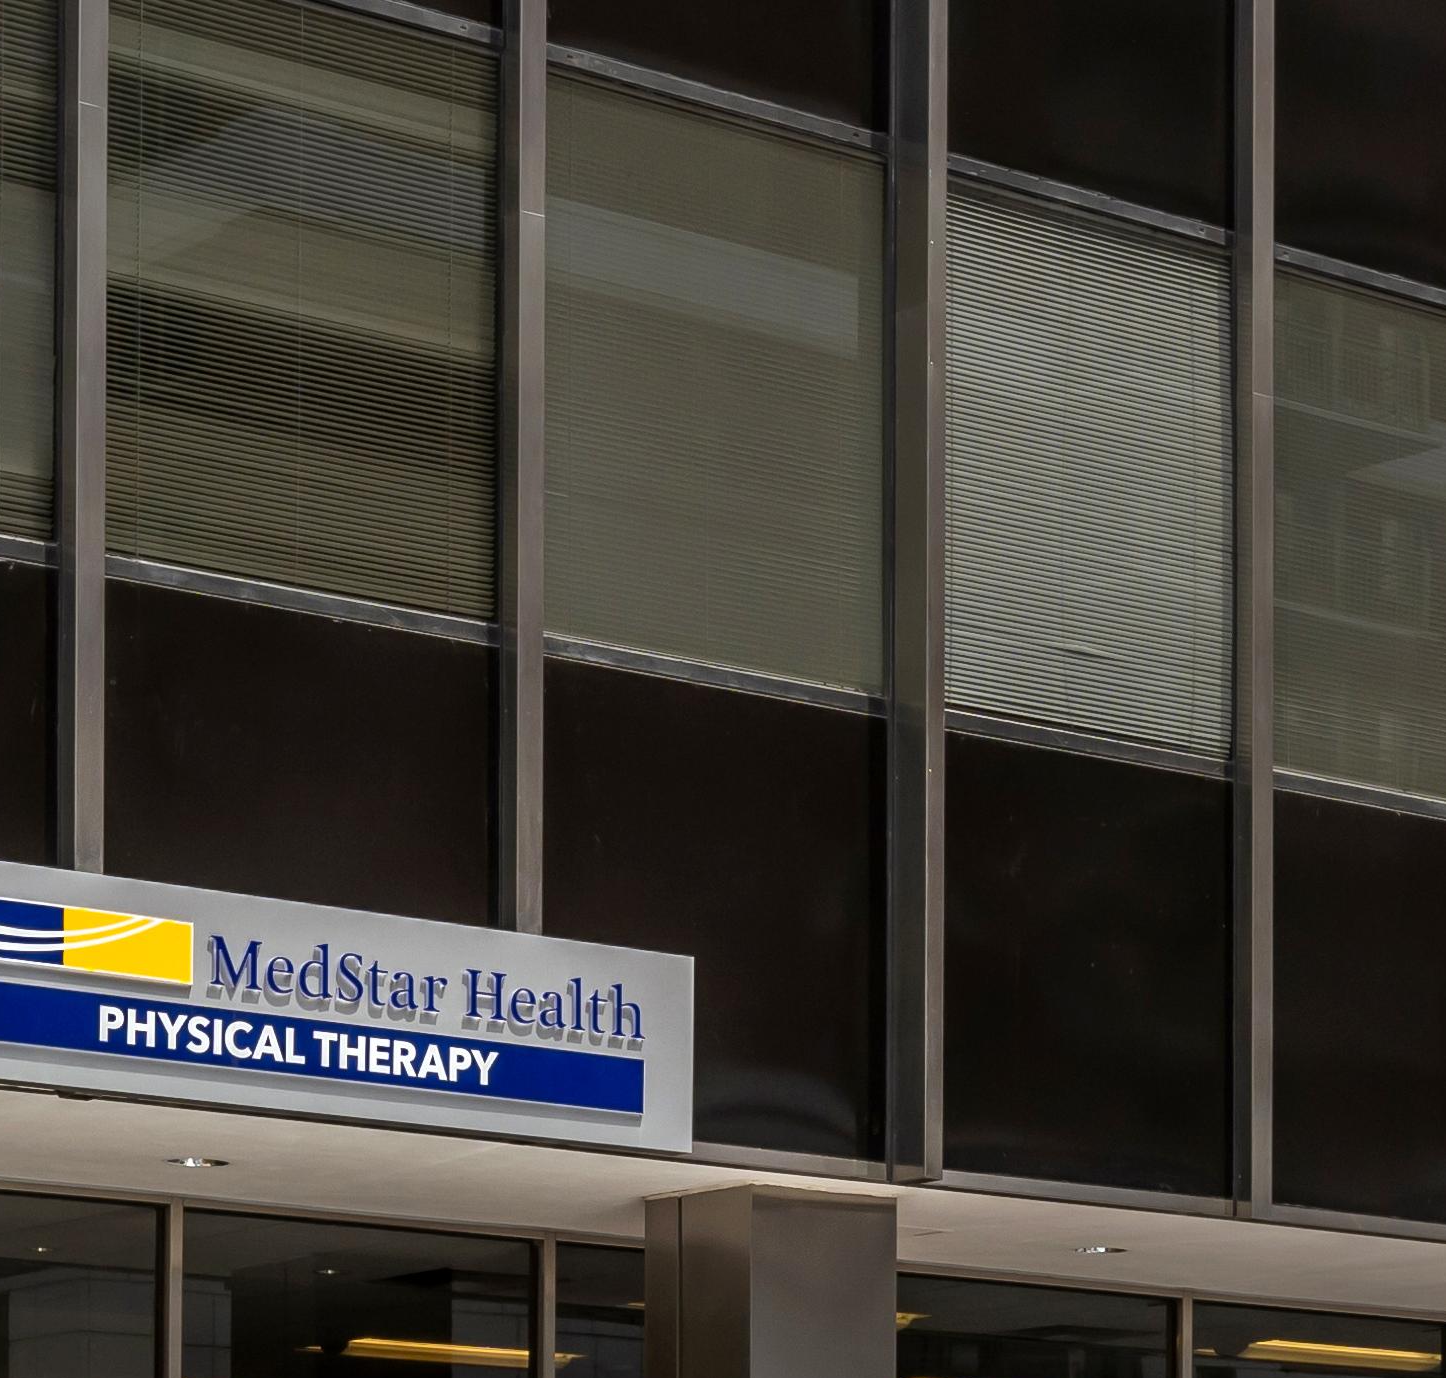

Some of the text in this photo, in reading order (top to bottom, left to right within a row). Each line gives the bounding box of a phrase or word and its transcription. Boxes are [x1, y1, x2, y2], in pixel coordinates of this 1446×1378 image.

[209, 934, 646, 1040] MedStar Health
[98, 1005, 500, 1087] PHYSICAL THERAPY
